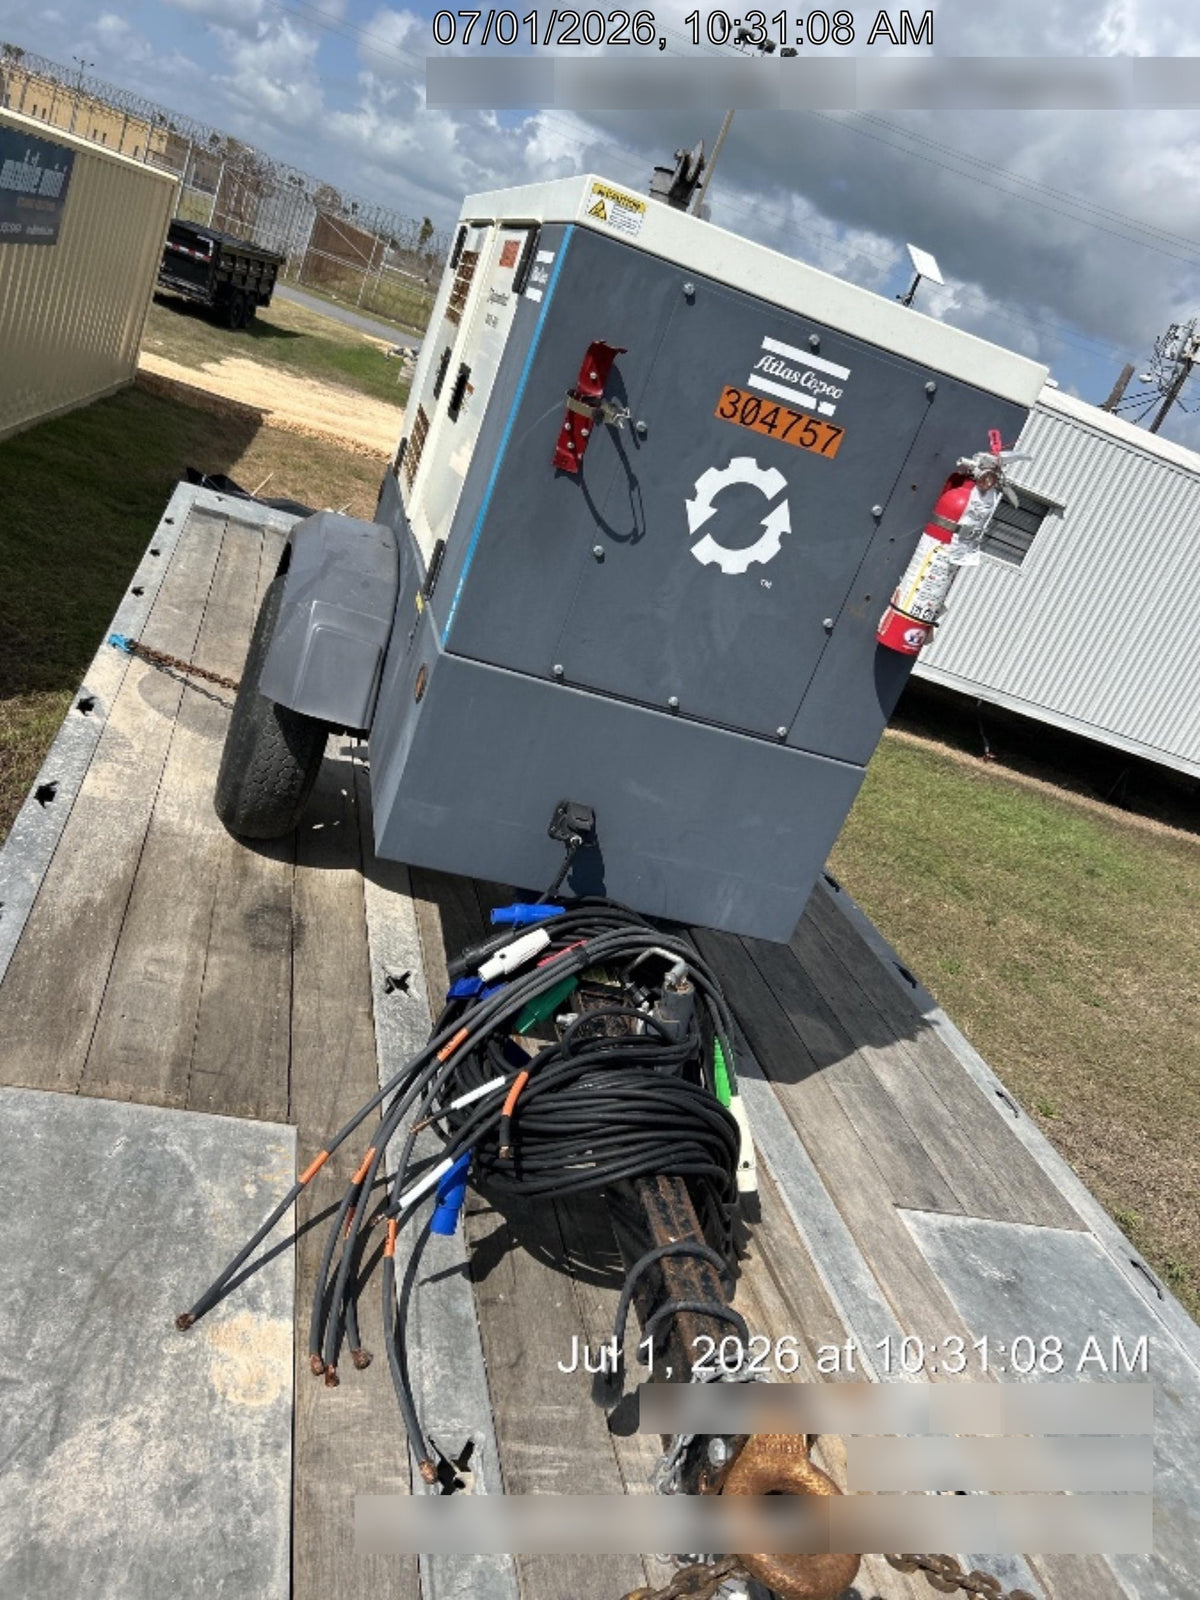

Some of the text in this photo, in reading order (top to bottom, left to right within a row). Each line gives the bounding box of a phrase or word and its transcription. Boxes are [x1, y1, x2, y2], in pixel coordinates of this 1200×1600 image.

[754, 355, 844, 400] Atlas Copco
[719, 388, 843, 454] 304757
